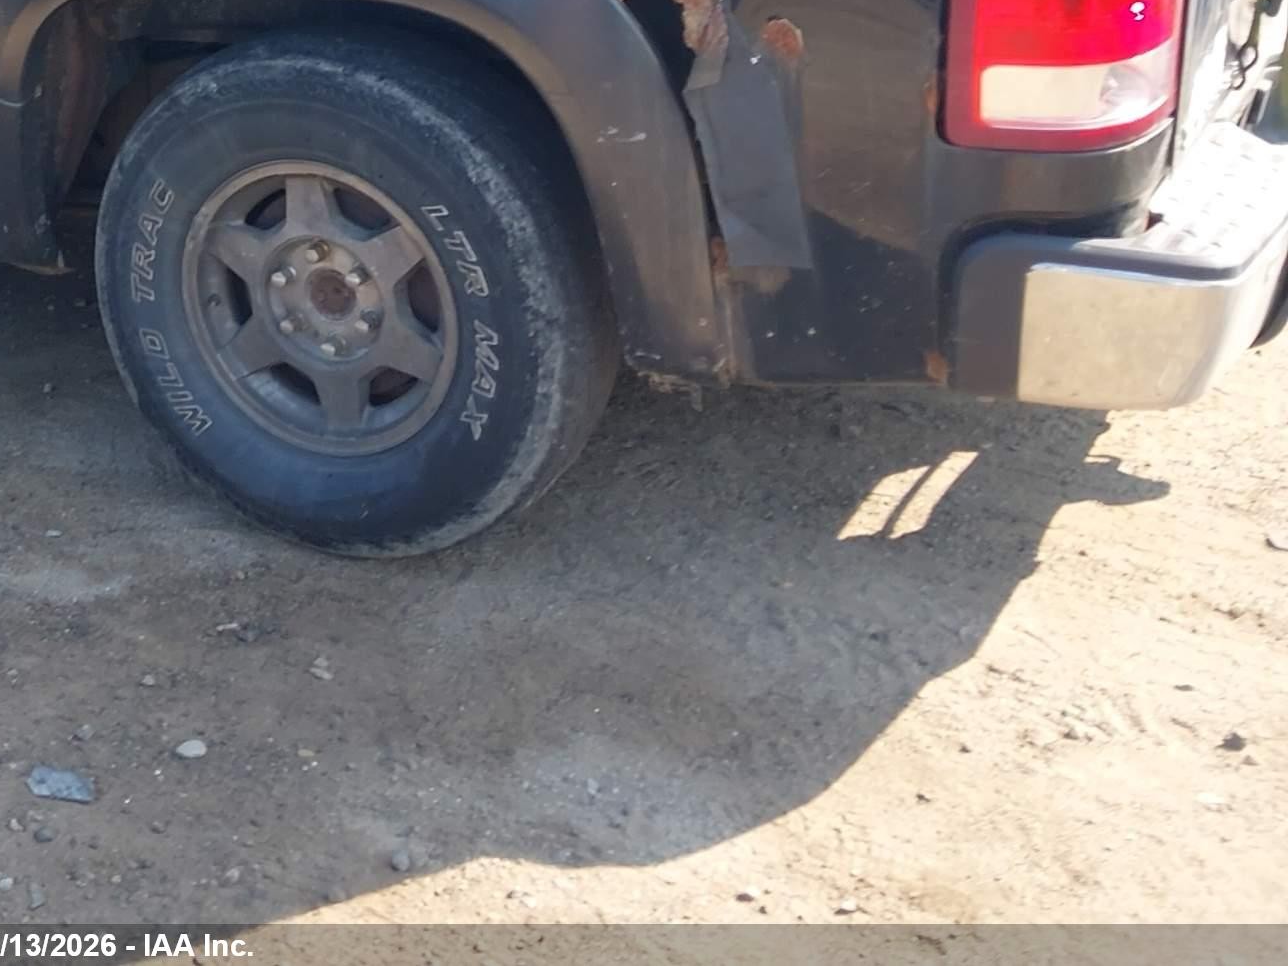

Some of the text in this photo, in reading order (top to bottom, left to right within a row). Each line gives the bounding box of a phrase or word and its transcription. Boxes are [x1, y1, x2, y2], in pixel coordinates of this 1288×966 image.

[130, 177, 213, 436] WILD TRAC
[420, 204, 500, 441] LTR MAX
